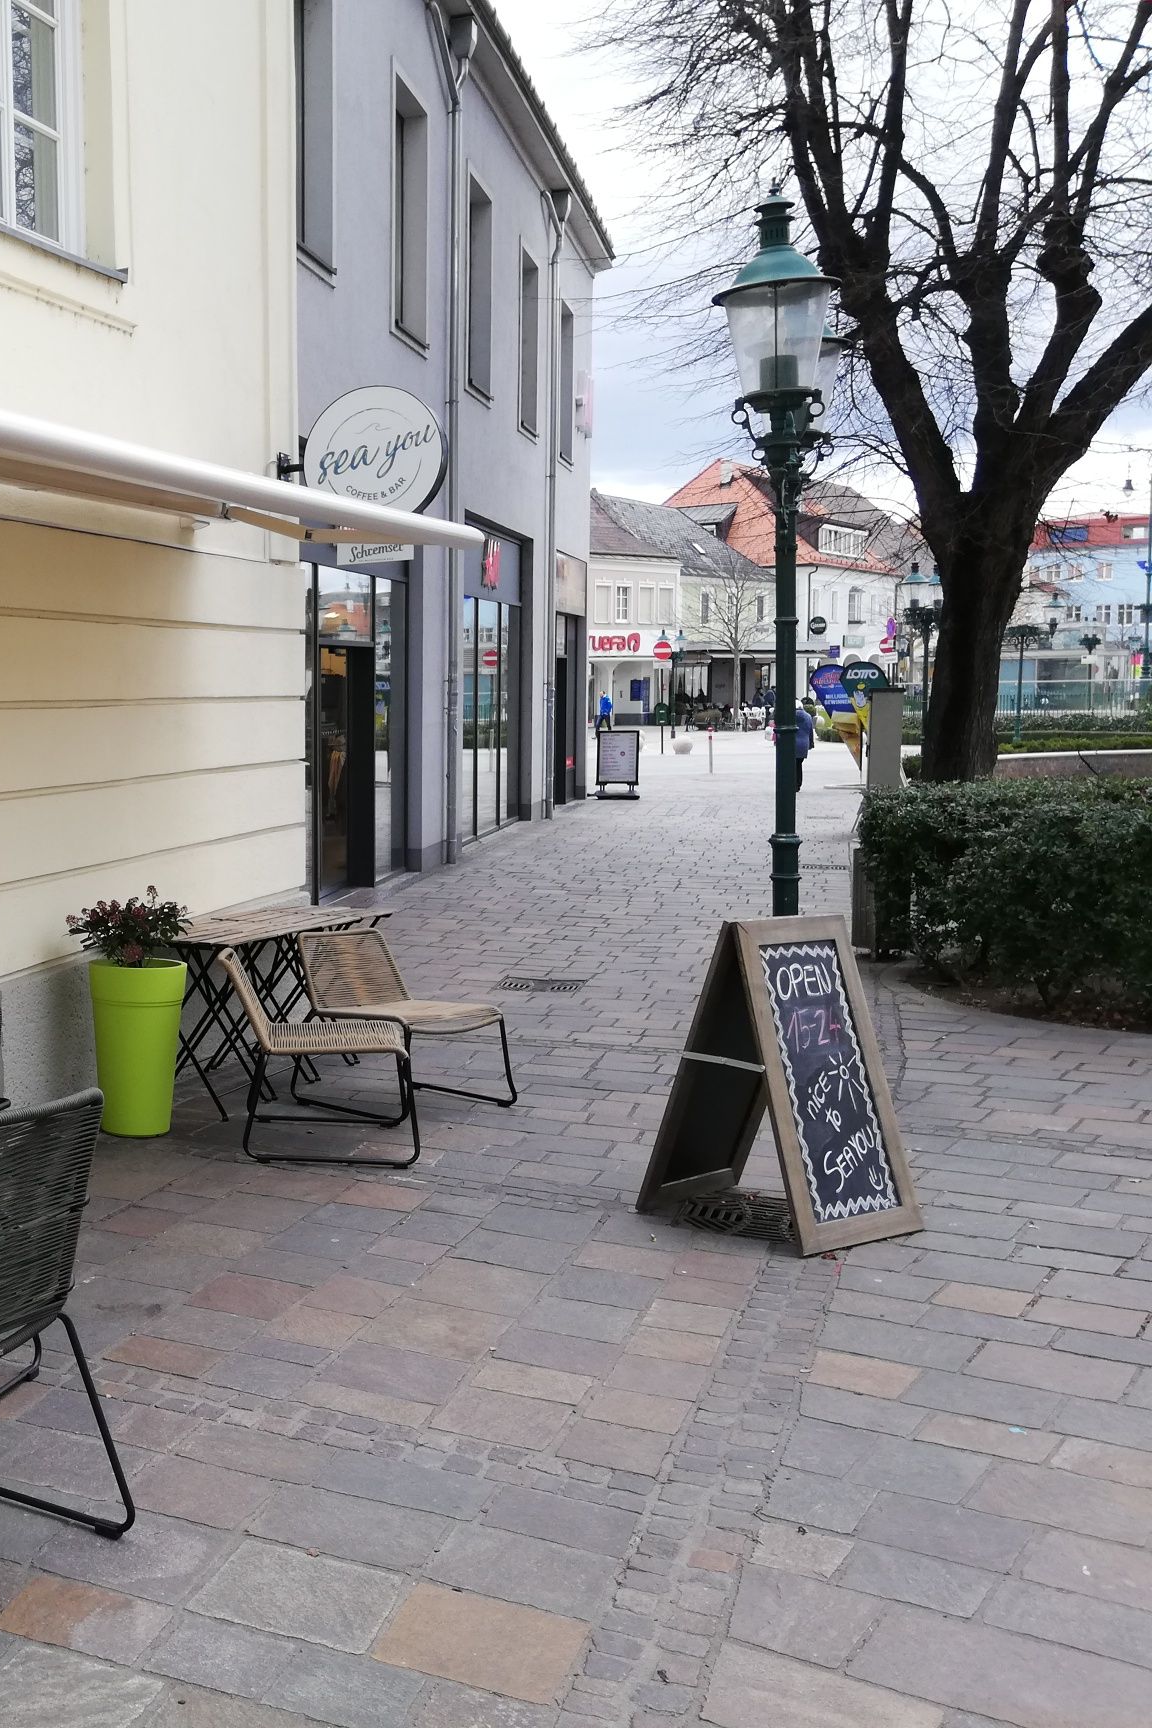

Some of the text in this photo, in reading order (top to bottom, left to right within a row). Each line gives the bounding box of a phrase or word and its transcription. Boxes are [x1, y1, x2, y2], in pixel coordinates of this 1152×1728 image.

[318, 424, 436, 485] sea you
[345, 476, 407, 501] COFFEE & BAR
[846, 669, 879, 679] LOTTO
[776, 962, 832, 1001] OPEN
